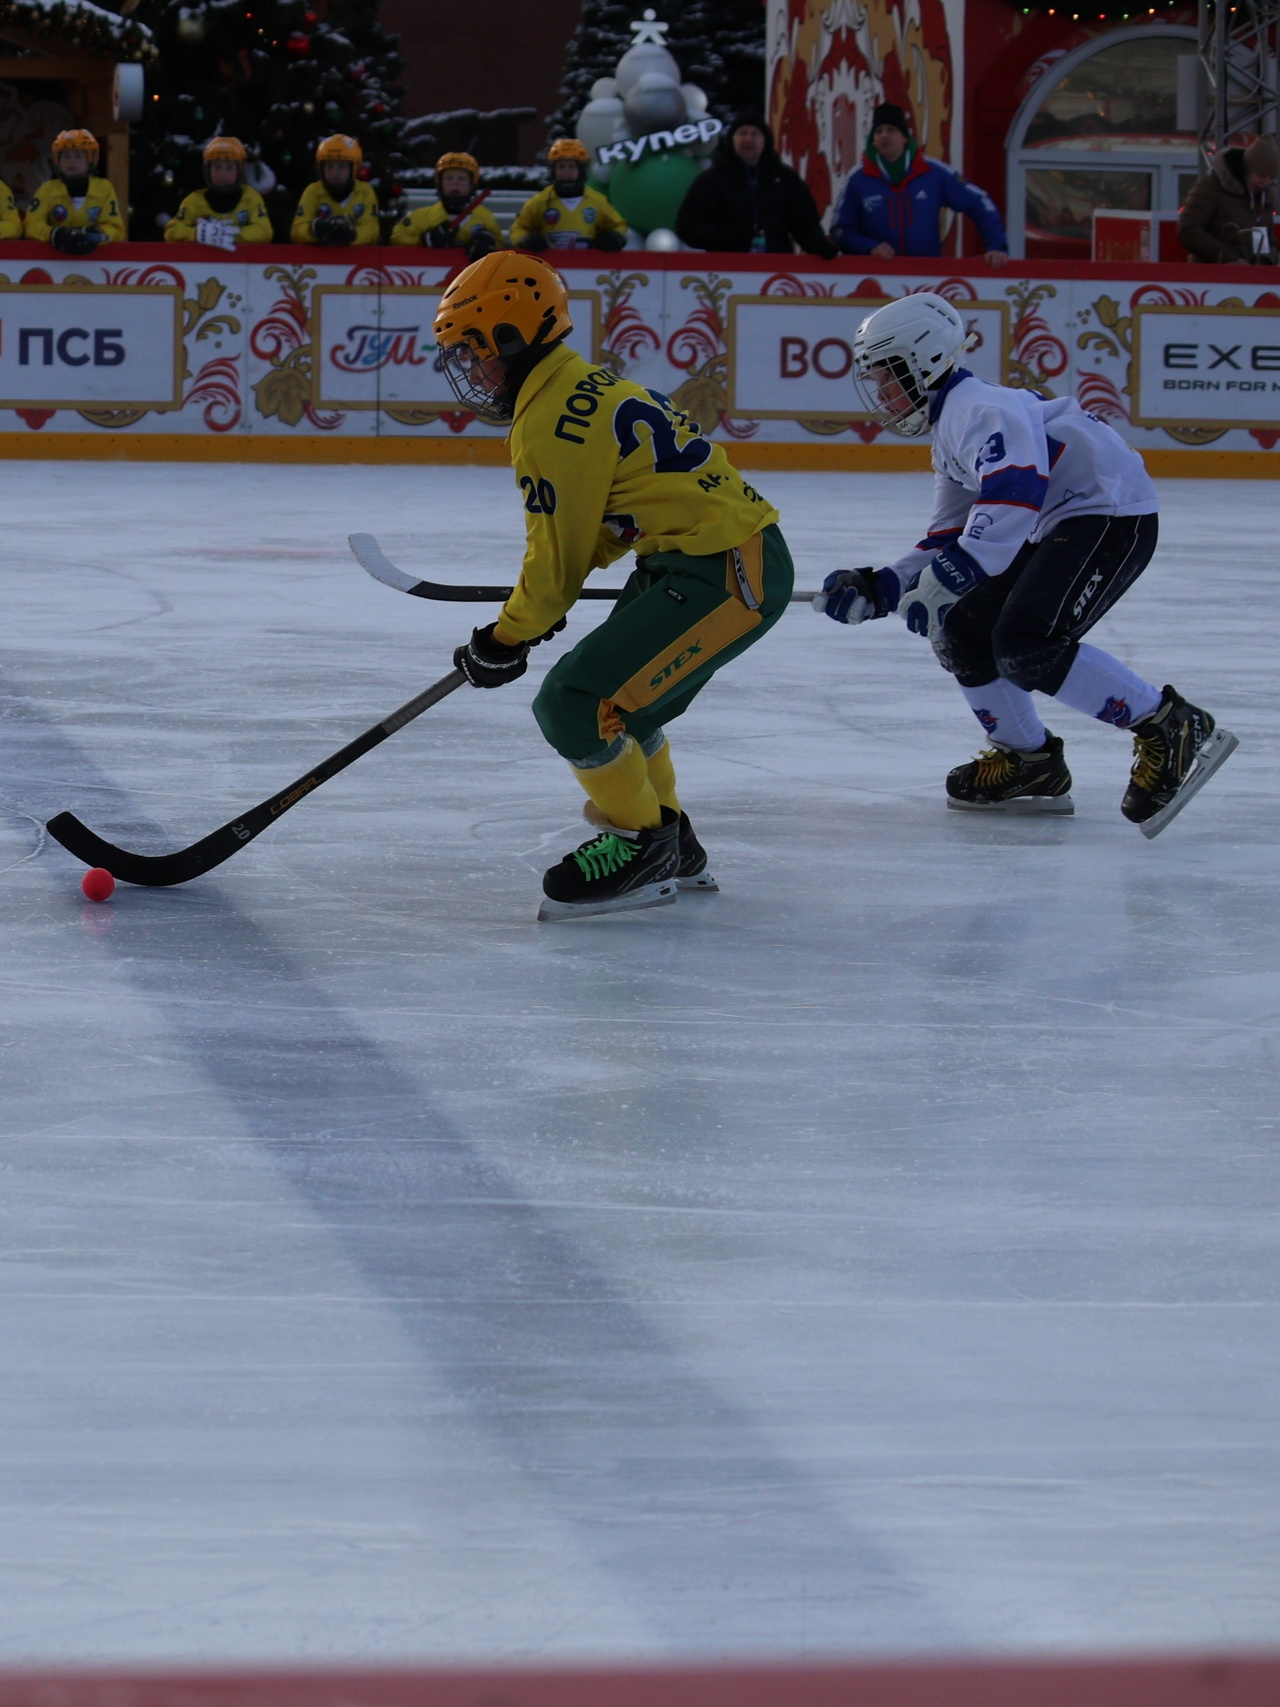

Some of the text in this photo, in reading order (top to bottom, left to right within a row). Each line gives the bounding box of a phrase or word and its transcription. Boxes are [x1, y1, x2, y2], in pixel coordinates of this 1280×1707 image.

[597, 117, 724, 164] купер
[452, 293, 479, 311] Reebok
[18, 327, 126, 367] ПСБ
[554, 367, 622, 444] ПОРО
[1163, 380, 1220, 390] BORN
[1226, 381, 1267, 391] FOR
[975, 431, 1006, 472] 3
[520, 475, 556, 515] 20
[1073, 567, 1104, 620] STEX
[649, 638, 703, 691] STEX
[231, 823, 251, 840] 20
